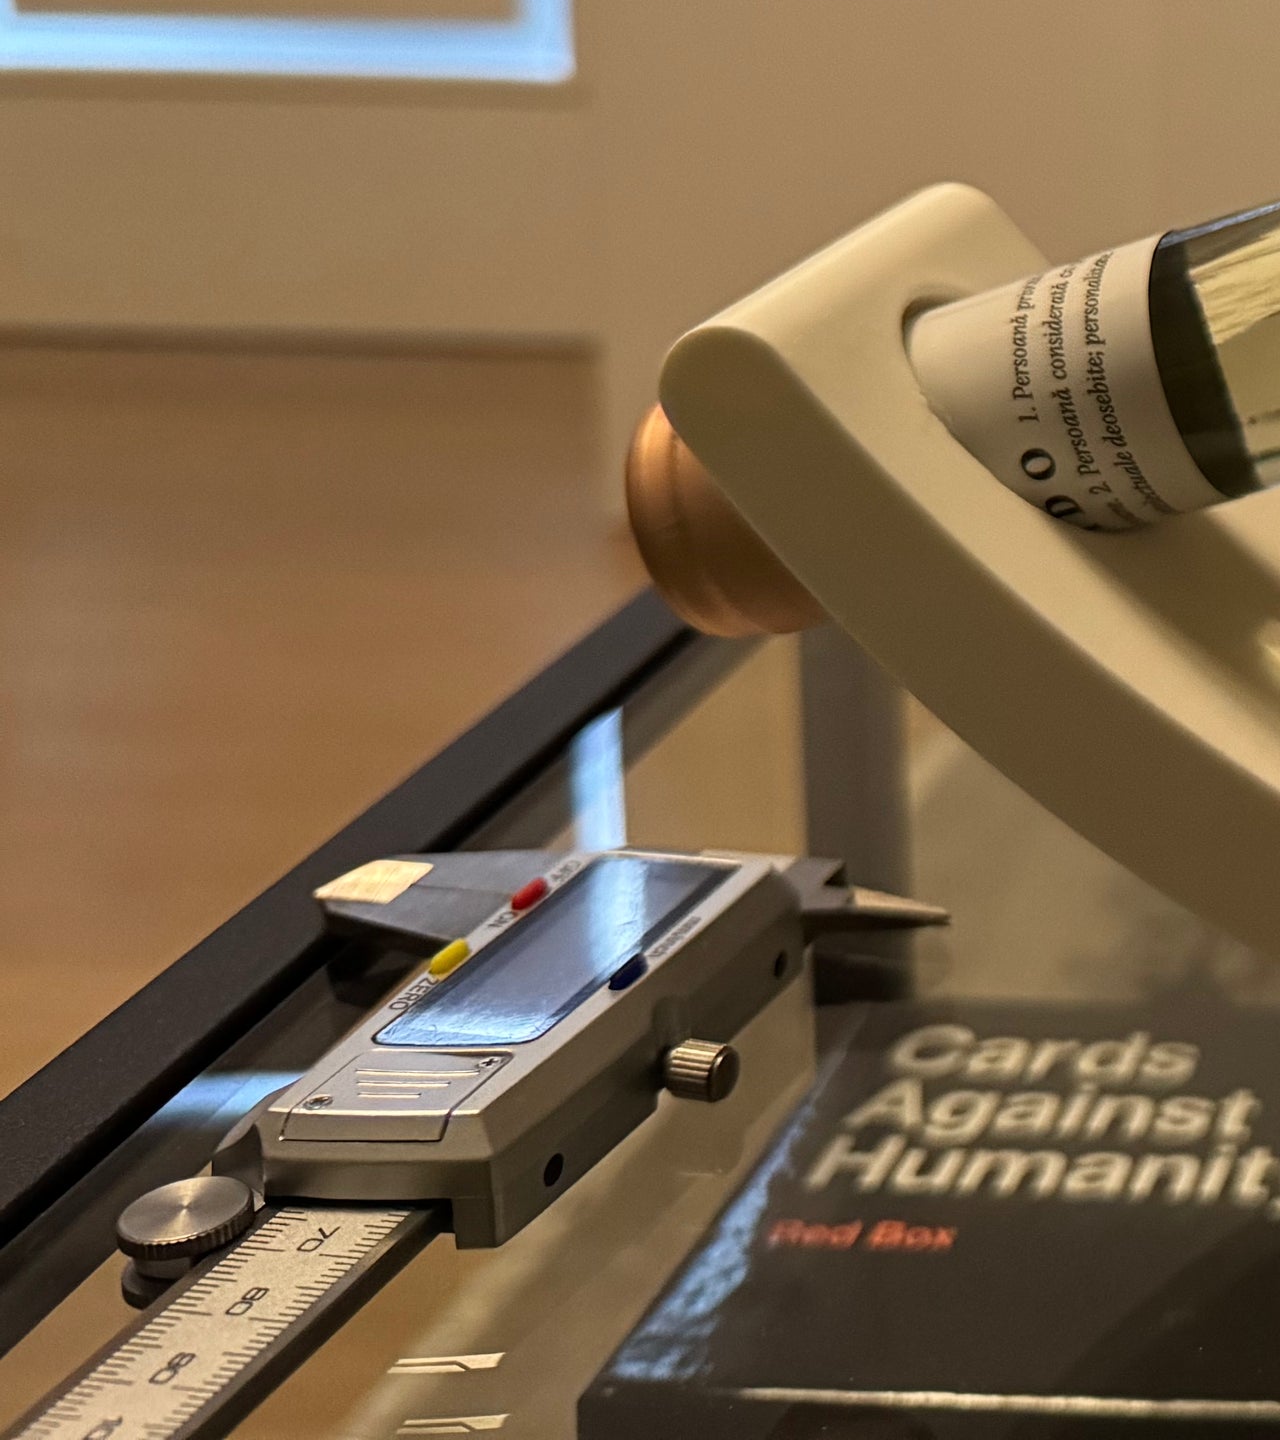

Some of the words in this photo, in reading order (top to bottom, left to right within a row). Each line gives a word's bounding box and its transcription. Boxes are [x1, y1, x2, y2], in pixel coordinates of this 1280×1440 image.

[1052, 387, 1101, 478] Persoană
[389, 975, 439, 1012] ZERO
[889, 1023, 1200, 1086] Cards
[845, 1076, 1262, 1146] Against
[295, 1226, 341, 1252] 70
[766, 1218, 864, 1252] Red
[866, 1218, 958, 1253] Box
[224, 1286, 270, 1317] 80
